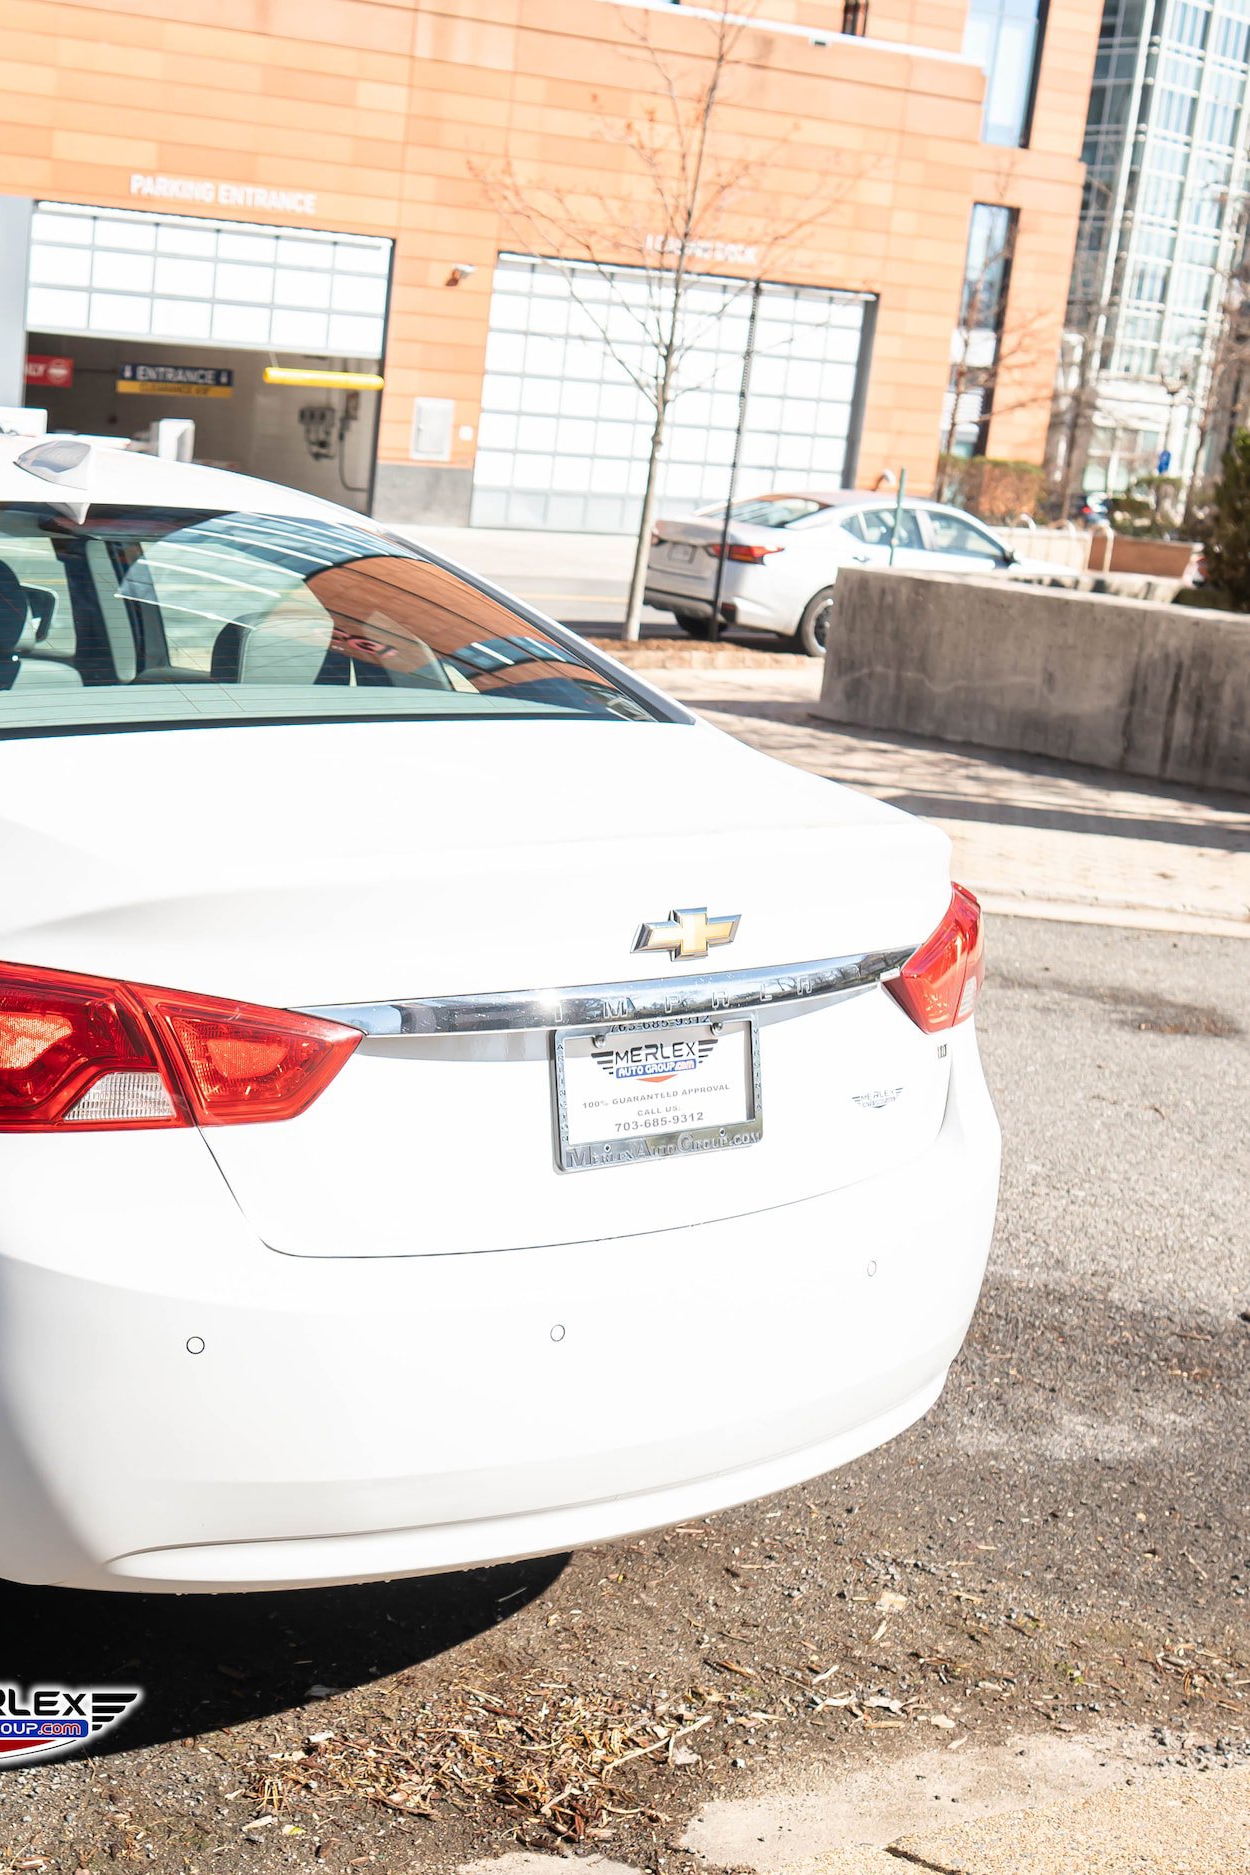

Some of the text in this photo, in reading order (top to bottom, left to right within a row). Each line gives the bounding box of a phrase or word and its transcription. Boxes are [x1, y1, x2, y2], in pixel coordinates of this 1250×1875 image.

[129, 174, 317, 215] PARKING ENTRANCE
[135, 365, 217, 385] ENTRANCE
[553, 977, 815, 1023] IMPALA
[614, 1041, 696, 1066] MERLEX
[618, 1066, 644, 1078] AUTO
[582, 1083, 731, 1110] 100% GUARANTEED APPROVAL
[614, 1111, 705, 1133] 703-685-9312
[636, 1108, 663, 1117] CALL
